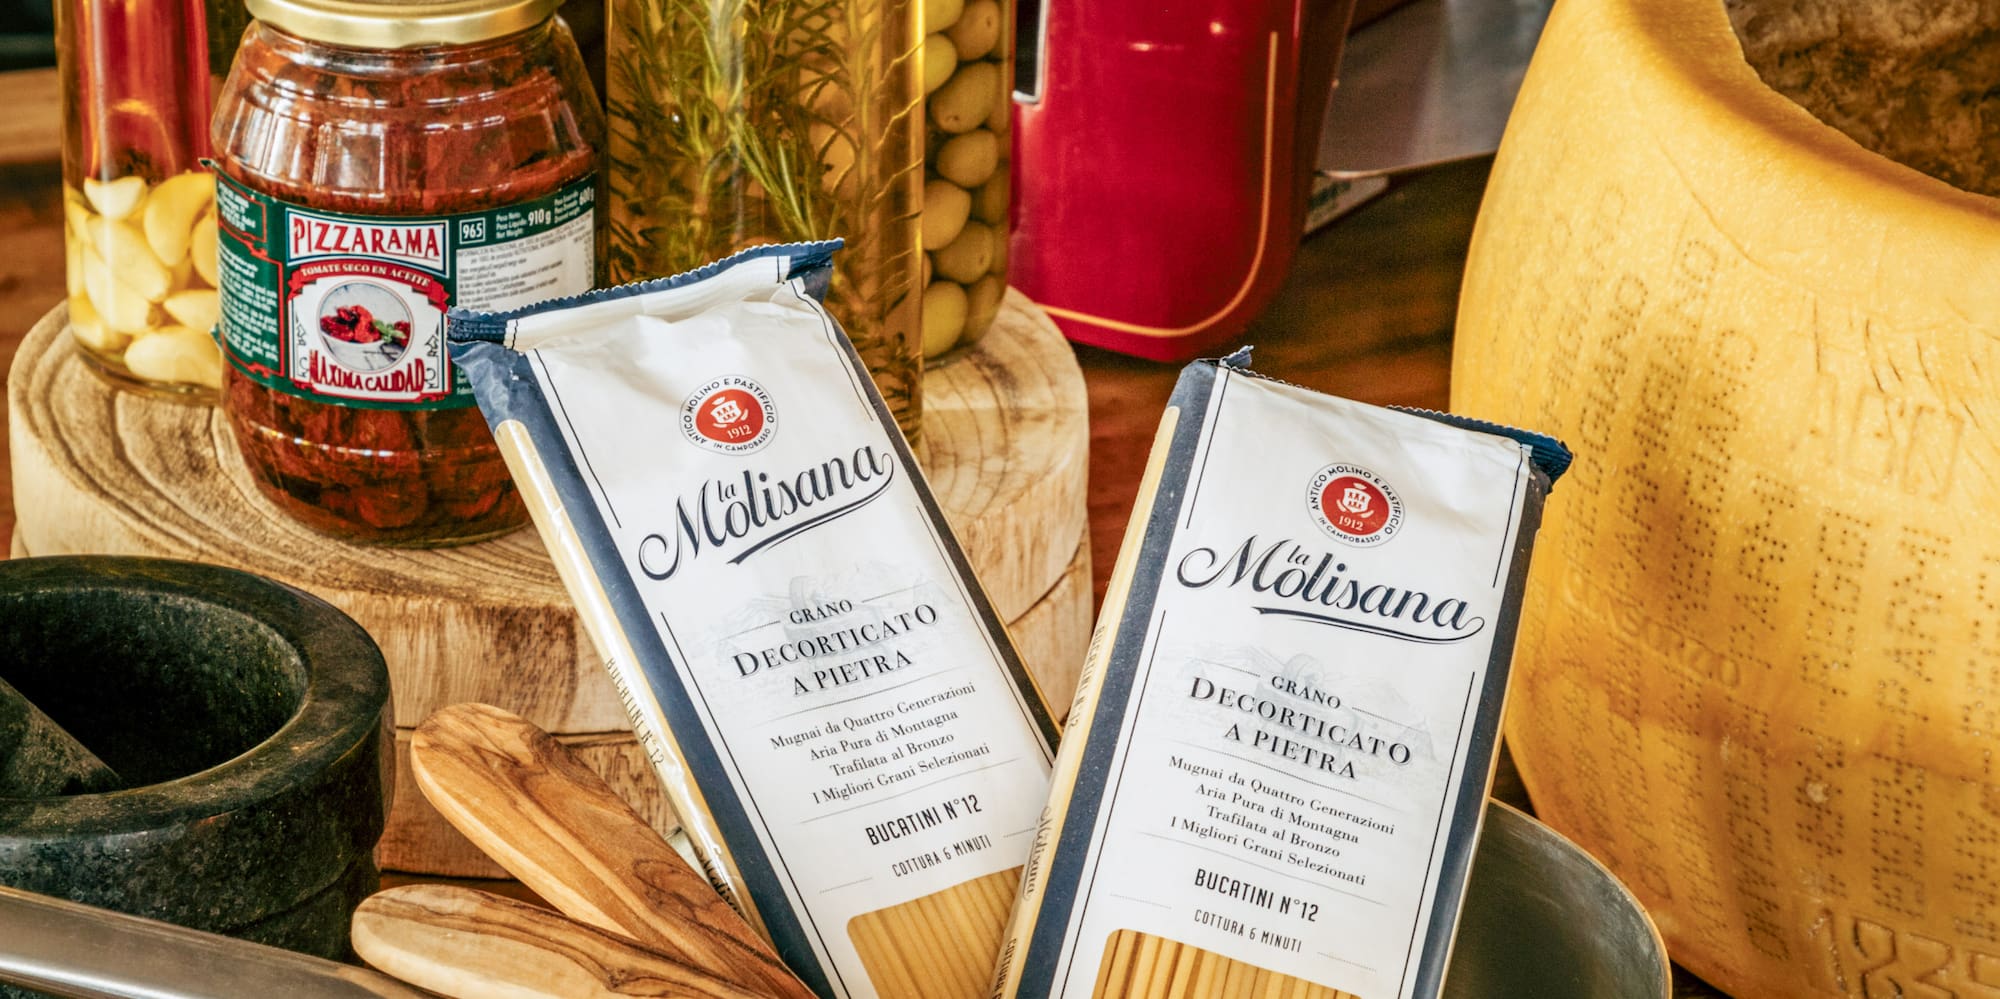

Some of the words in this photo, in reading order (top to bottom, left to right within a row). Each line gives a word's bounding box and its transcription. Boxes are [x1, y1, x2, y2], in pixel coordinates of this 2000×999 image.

[293, 217, 440, 260] PIZZARAMA
[463, 223, 483, 239] 965
[301, 263, 341, 277] TOMATE
[342, 263, 370, 273] SECO
[372, 264, 387, 275] EN
[390, 268, 431, 287] ACEITE
[365, 358, 425, 392] CALIDAD
[687, 381, 720, 413] MOLINO
[724, 378, 730, 386] E
[734, 378, 775, 423] PASTIFICIO
[683, 415, 708, 444] ANTICO
[725, 428, 771, 451] CAMPOBASSO
[727, 425, 752, 439] 1912
[639, 445, 895, 581] Molisana
[717, 480, 736, 502] la
[1310, 474, 1328, 511] ANTICO
[1328, 465, 1372, 479] MOLINO
[1381, 485, 1402, 535] PASTIFICIO
[1318, 517, 1327, 525] IN
[1327, 525, 1380, 543] CAMPOBASSO
[1339, 515, 1364, 531] 1912
[1287, 545, 1310, 565] la
[1177, 535, 1485, 644] Molisana
[789, 599, 853, 625] GRANO
[731, 603, 938, 678] DECORTICATO
[792, 676, 809, 696] A
[813, 650, 912, 690] PIETRA
[1271, 675, 1341, 709] GRANO
[770, 726, 822, 750] Mugnai
[824, 720, 841, 736] da
[842, 708, 895, 731] Quattro
[896, 681, 977, 715] Generazioni
[809, 746, 837, 761] Aria
[840, 737, 873, 754] Pura
[875, 730, 890, 744] di
[891, 710, 959, 740] Montagna
[1189, 676, 1412, 765] DECORTICATO
[829, 756, 888, 777] Trafilata
[891, 747, 905, 761] al
[906, 733, 955, 757] Bronzo
[1223, 723, 1241, 742] A
[1253, 729, 1357, 779] PIETRA
[812, 791, 821, 805] I
[822, 779, 875, 804] Migliori
[876, 766, 916, 787] Grani
[917, 743, 991, 773] Selezionati
[1168, 755, 1224, 780] Mugnai
[1227, 772, 1245, 787] da
[1250, 778, 1305, 807] Quattro
[1309, 799, 1396, 835] Generazioni
[865, 806, 943, 846] BUCATINI
[943, 794, 983, 820] N°12
[1195, 783, 1227, 800] Aria
[1231, 792, 1265, 814] Pura
[1270, 806, 1284, 820] di
[1287, 812, 1360, 845] Montagna
[1206, 805, 1268, 835] Trafilata
[1272, 829, 1286, 841] al
[1290, 833, 1341, 858] Bronzo
[891, 849, 941, 878] COTTURA
[942, 846, 952, 860] 6
[952, 834, 992, 857] MINUTI
[1170, 815, 1177, 828] I
[1180, 817, 1239, 846] Migliori
[1242, 838, 1283, 861] Grani
[1286, 852, 1367, 886] Selezionati
[1194, 868, 1275, 910] BUCATINI
[1279, 896, 1319, 922] N°12
[1193, 909, 1245, 937] COTTURA
[1249, 927, 1257, 940] 6
[1260, 930, 1303, 953] MINUTI
